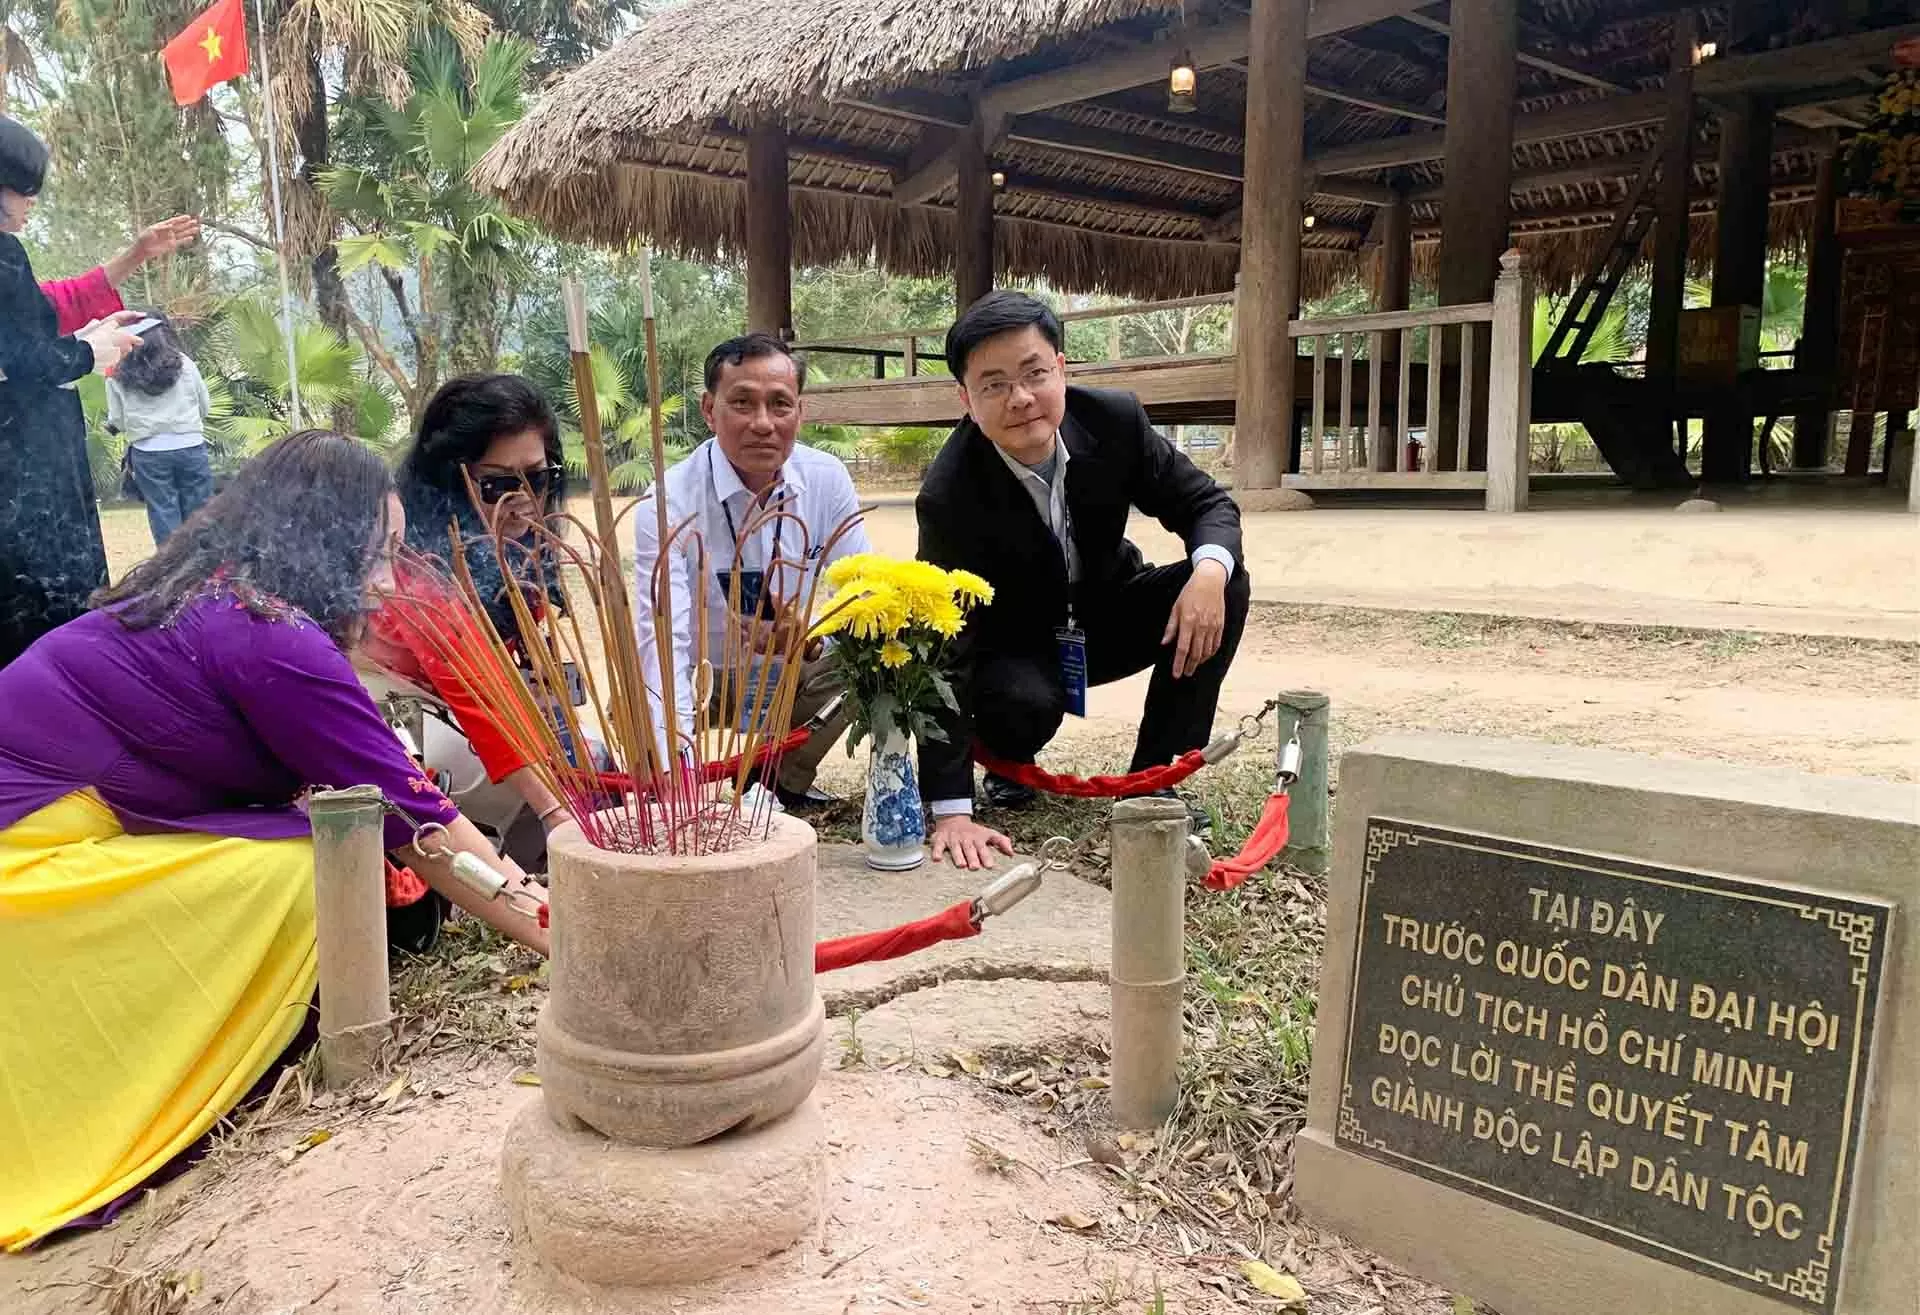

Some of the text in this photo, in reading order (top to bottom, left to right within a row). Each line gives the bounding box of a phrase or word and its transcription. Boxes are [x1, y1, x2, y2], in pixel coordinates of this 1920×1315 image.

[1382, 913, 1840, 1054] TRƯỚC QUỐC DÂN ĐẠI HỘI
[1528, 887, 1665, 945] TẠI ĐÂY
[1378, 1023, 1809, 1177] ĐỌC LỜI THỀ QUYẾT TÂM
[1401, 973, 1794, 1107] CHỦ TỊCH HỒ CHÍ MINH
[1371, 1076, 1803, 1241] GIÀNH ĐỘC LẬP DÂN TỘC
